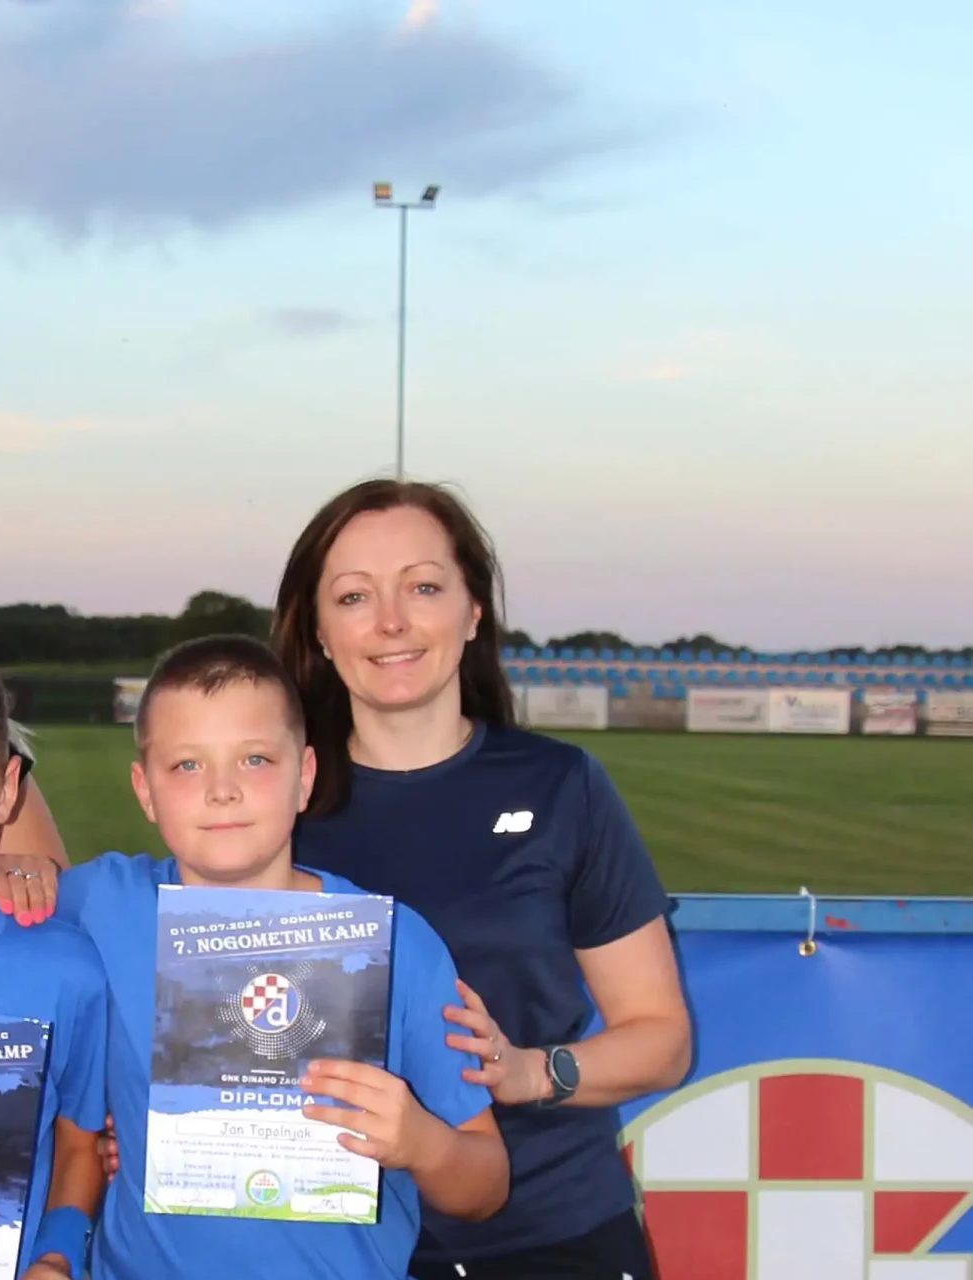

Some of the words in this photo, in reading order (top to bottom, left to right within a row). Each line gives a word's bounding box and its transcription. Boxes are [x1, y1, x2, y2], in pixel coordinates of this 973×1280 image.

[173, 941, 192, 955] 7.
[197, 929, 315, 953] NOGOMETNI
[319, 922, 379, 941] KAMP
[221, 1074, 239, 1083] GNK
[242, 1075, 277, 1085] DINAMO
[220, 1090, 316, 1107] DIPLOMA
